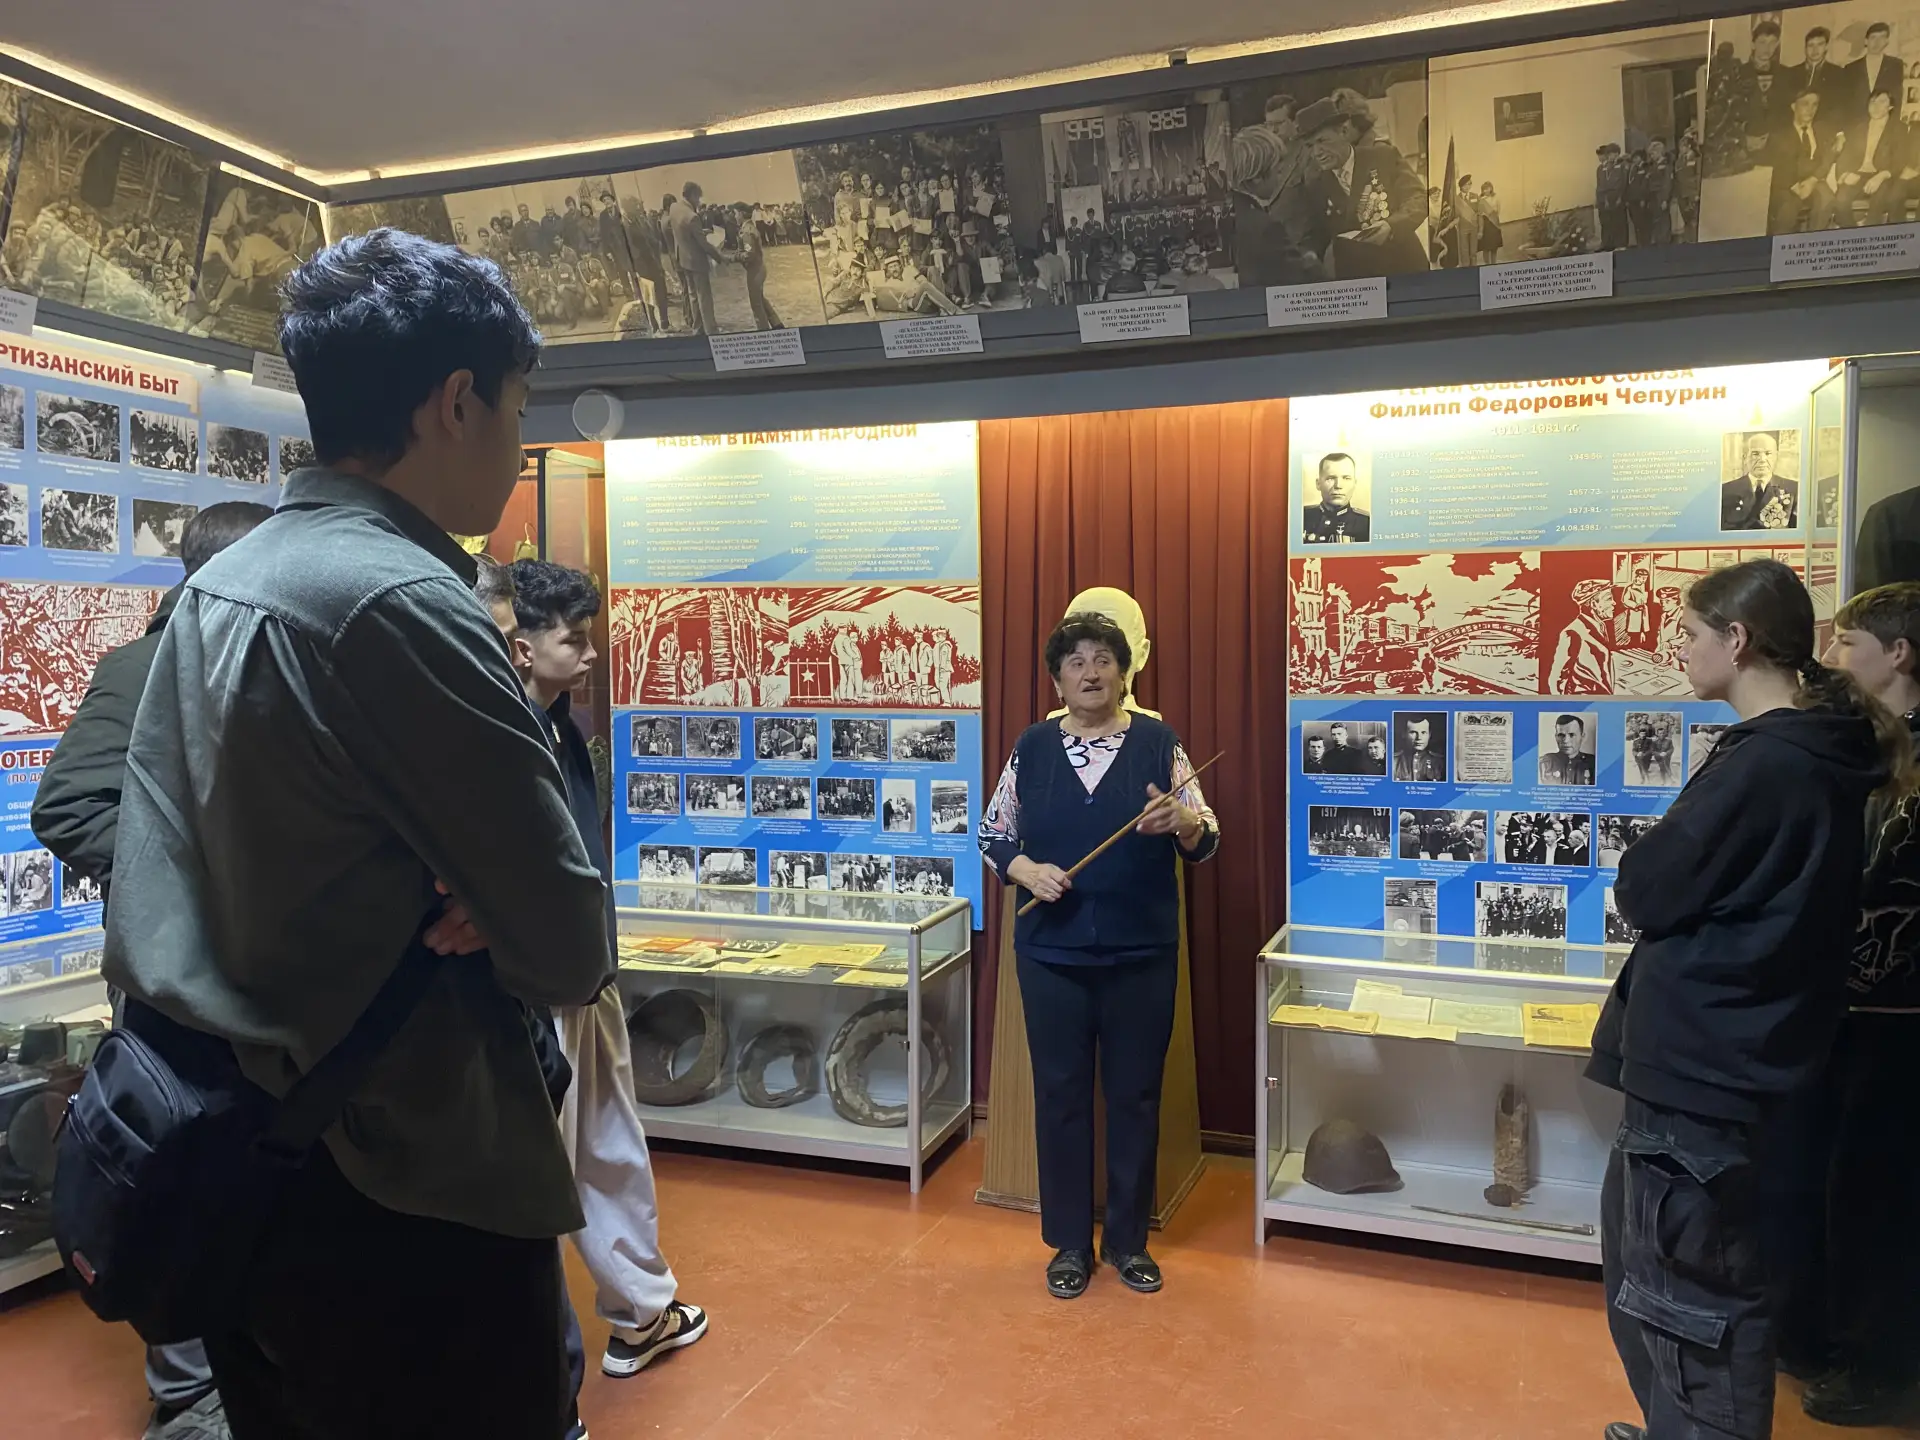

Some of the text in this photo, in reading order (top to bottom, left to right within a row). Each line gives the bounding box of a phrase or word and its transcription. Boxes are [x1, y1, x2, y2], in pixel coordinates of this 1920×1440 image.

[140, 373, 179, 395] БЫТ
[1369, 385, 1727, 419] Филипп Федорович Чепурин
[742, 429, 813, 445] ПАМЯТИ
